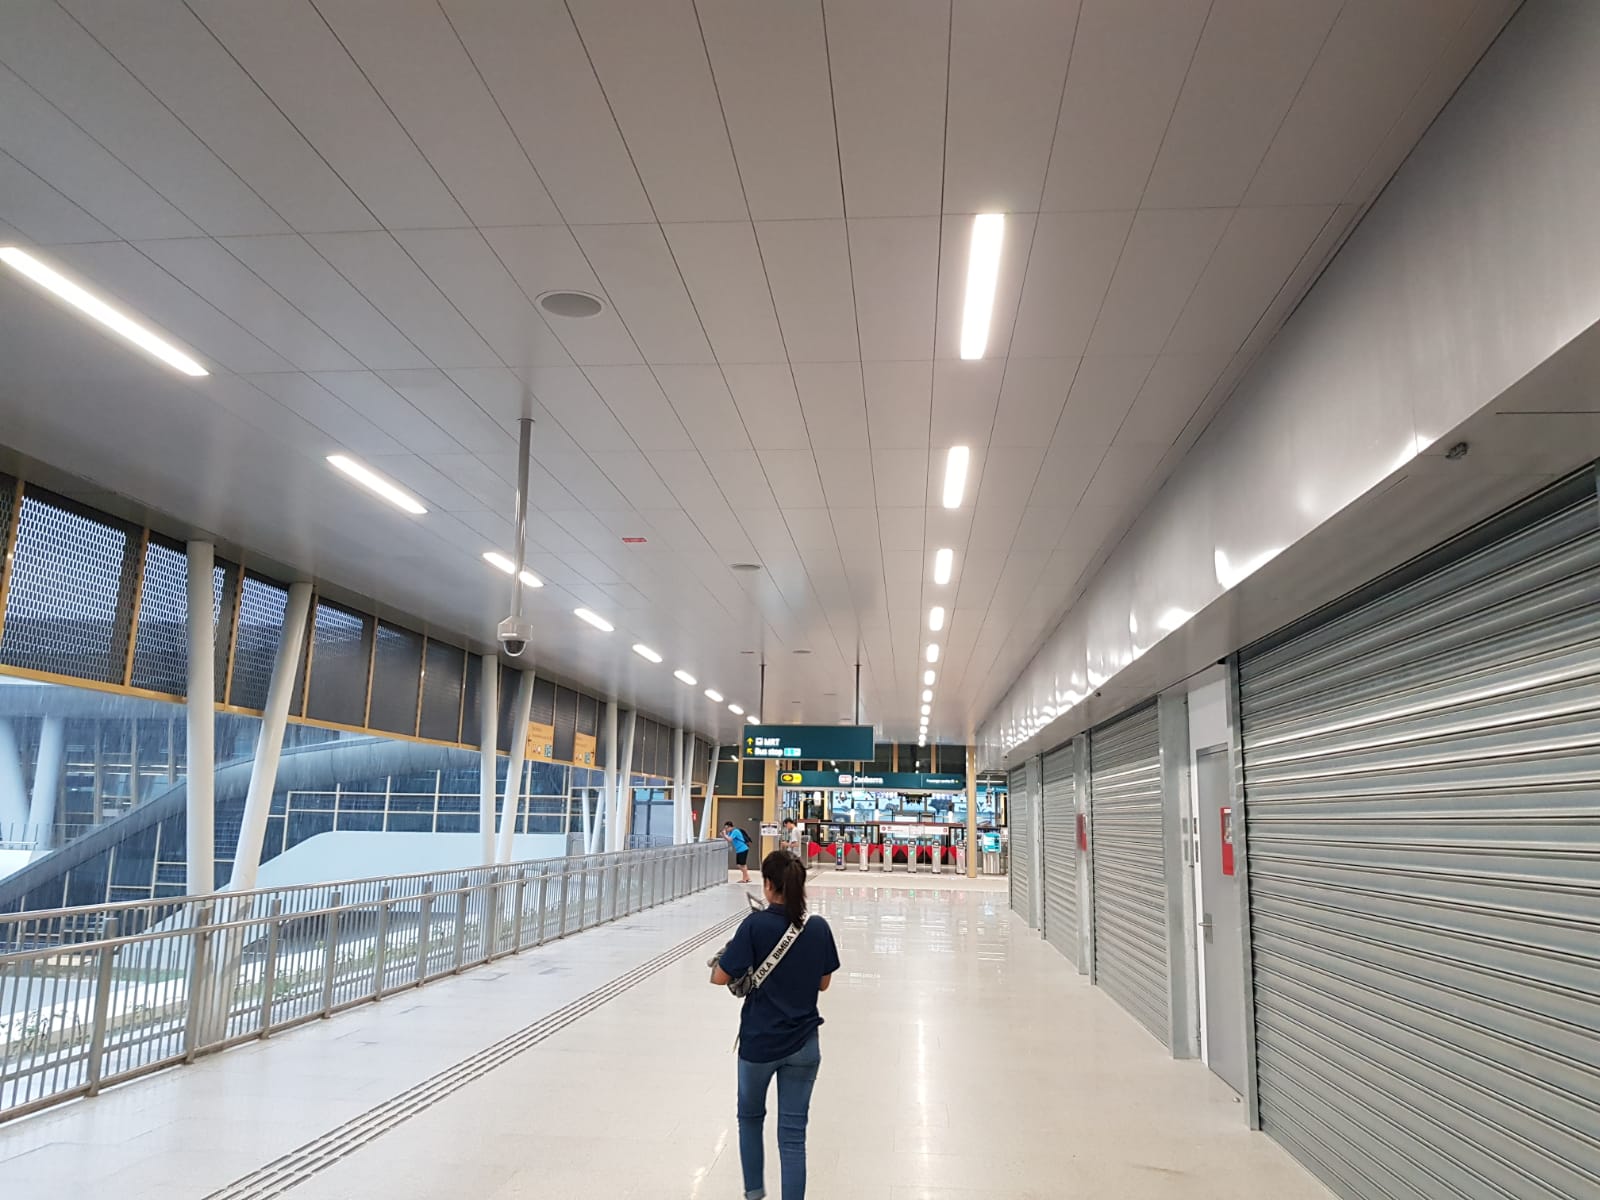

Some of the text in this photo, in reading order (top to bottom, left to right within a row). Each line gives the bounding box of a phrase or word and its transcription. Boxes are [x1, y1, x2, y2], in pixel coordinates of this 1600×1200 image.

[764, 738, 780, 746] MRT
[756, 962, 773, 981] LOLA
[772, 936, 794, 960] BIMBA
